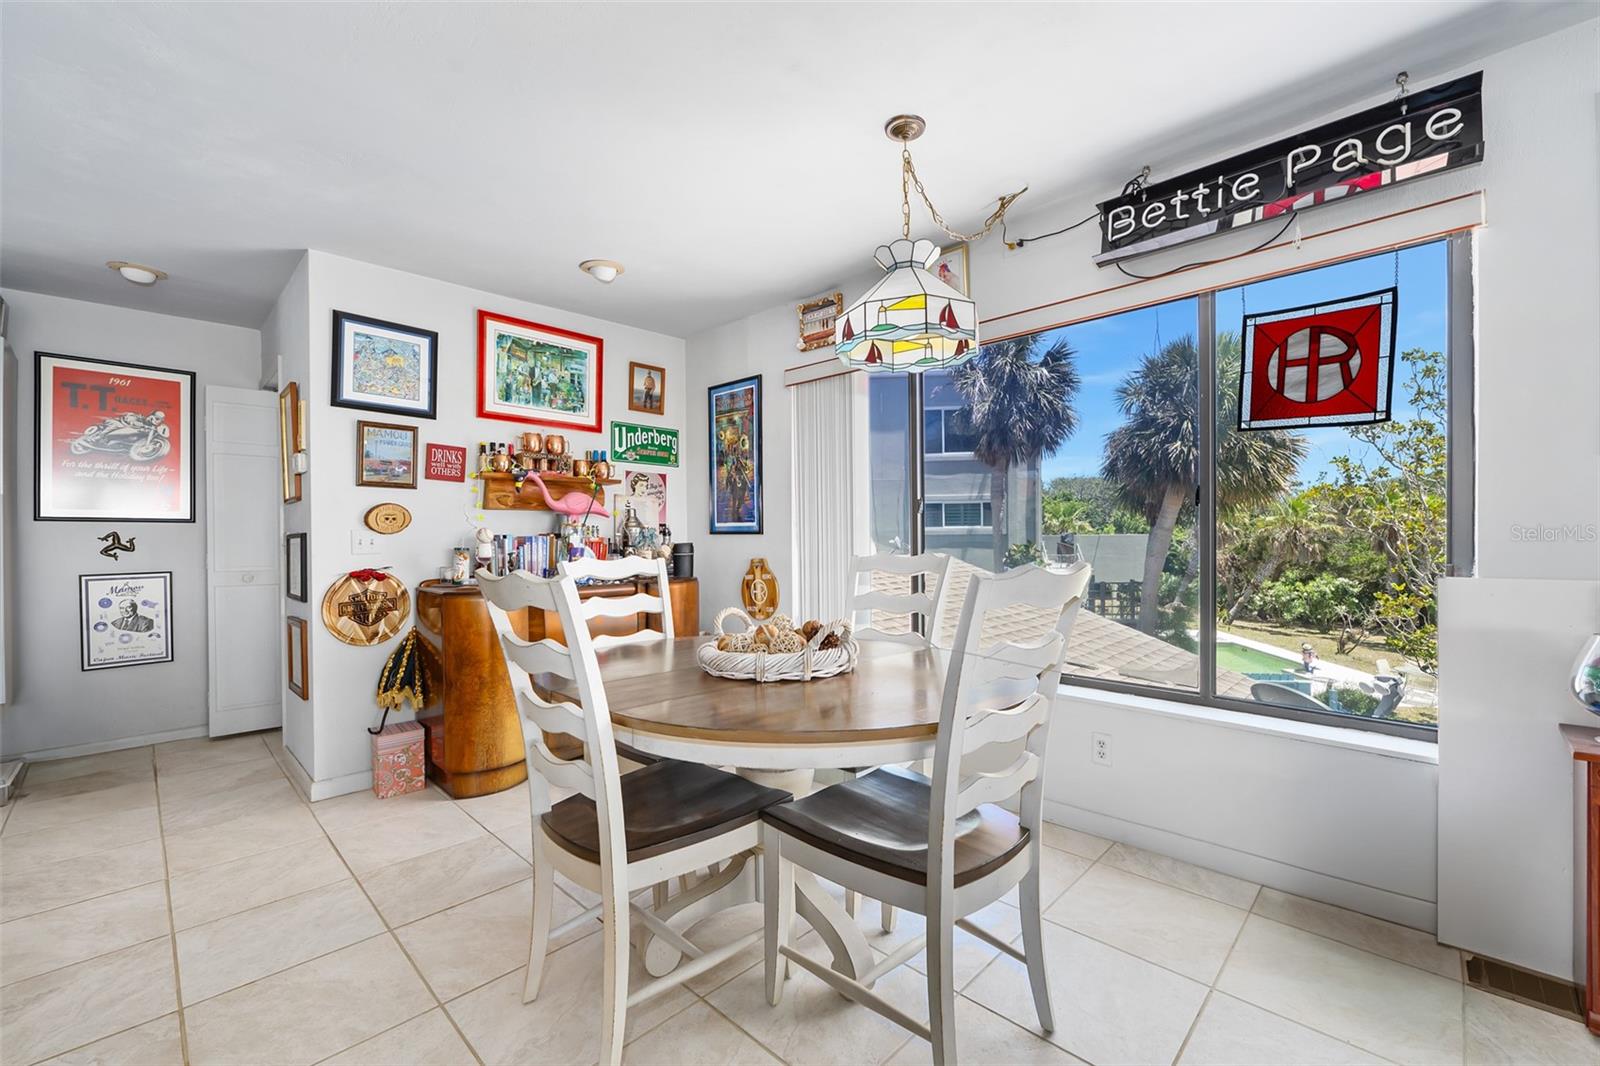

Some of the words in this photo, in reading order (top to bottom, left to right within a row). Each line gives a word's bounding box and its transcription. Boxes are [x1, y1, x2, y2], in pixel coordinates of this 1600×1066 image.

[1108, 172, 1260, 242] Bettie
[1286, 107, 1464, 189] Page
[109, 377, 131, 387] 1961
[614, 426, 677, 454] Underberg
[431, 448, 463, 464] DRINKS
[431, 467, 461, 477] OTHERS
